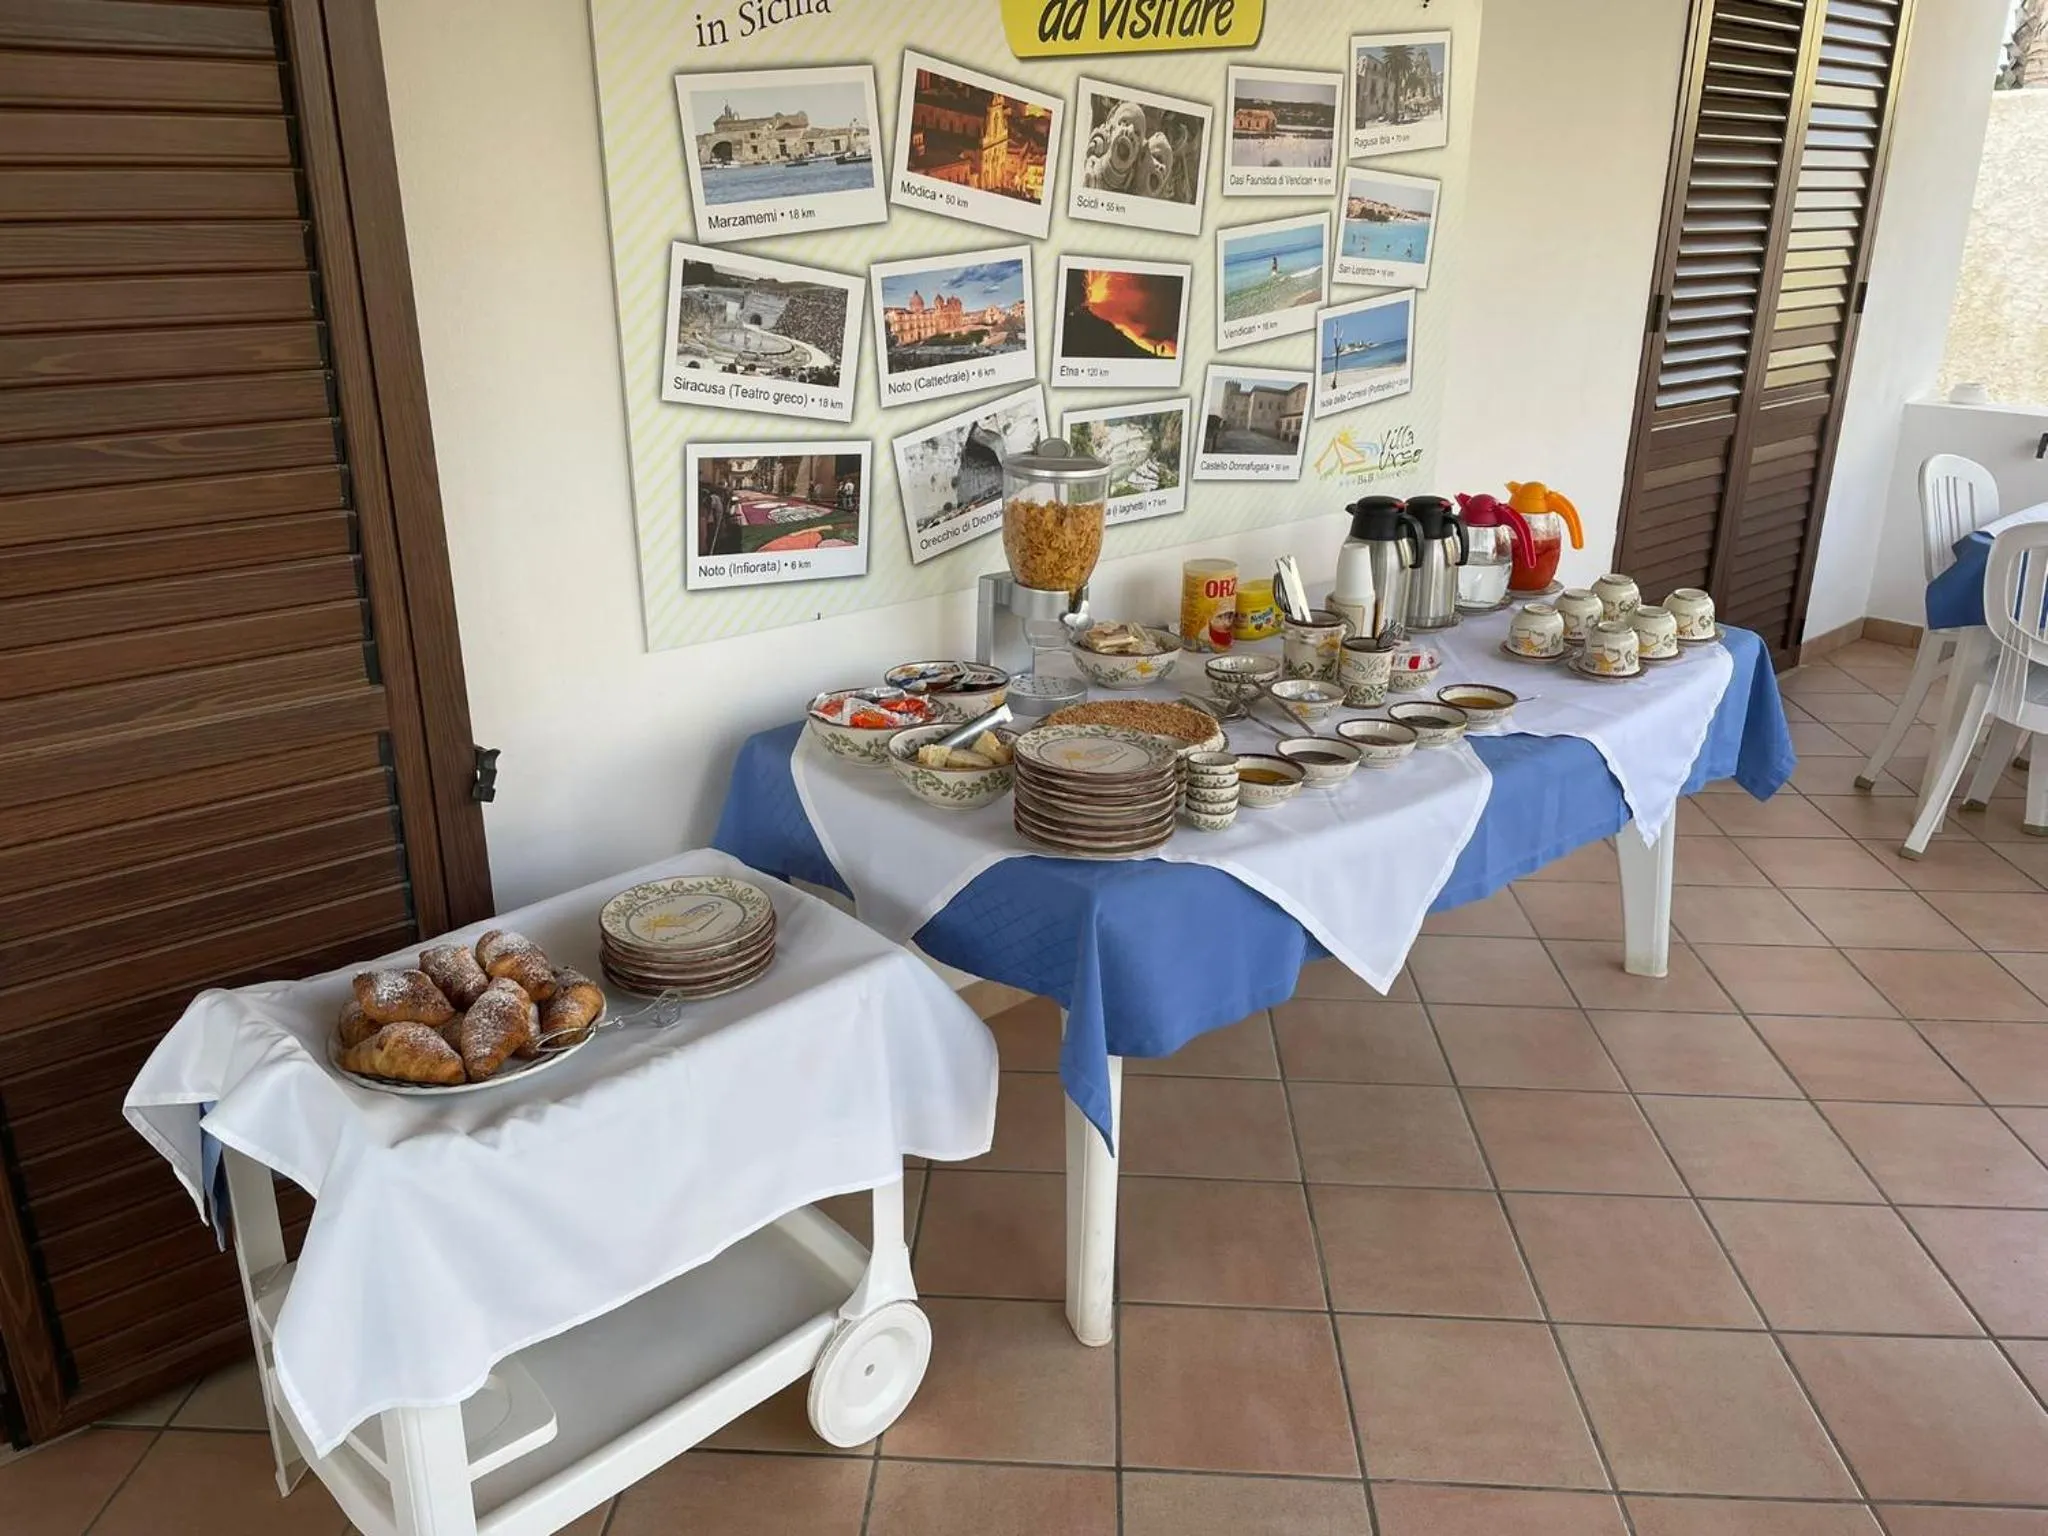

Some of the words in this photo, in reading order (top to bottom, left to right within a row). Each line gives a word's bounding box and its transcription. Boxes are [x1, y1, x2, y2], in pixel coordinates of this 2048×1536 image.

[696, 14, 729, 47] in
[1038, 0, 1089, 42] da
[1098, 0, 1235, 40] visitare
[901, 180, 936, 200] Modica
[945, 194, 955, 205] 50
[957, 196, 969, 208] km
[1077, 195, 1098, 209] Scicli
[1116, 204, 1126, 214] km
[708, 209, 778, 229] Marzamemi
[789, 209, 799, 219] 18
[801, 208, 816, 219] km
[888, 382, 911, 395] Noto
[914, 369, 970, 393] (Cattedrale)
[984, 367, 996, 377] km
[1060, 365, 1079, 377] Etna
[1099, 367, 1109, 377] km
[673, 376, 726, 395] Siracusa
[729, 384, 770, 401] (Teatro
[772, 392, 808, 408] greco)
[830, 399, 843, 409] km
[920, 517, 961, 549] Orecchio
[962, 511, 971, 532] di
[698, 565, 726, 577] Noto
[729, 560, 780, 578] (Infiorata)
[791, 561, 797, 570] 6
[798, 561, 811, 569] km
[1205, 577, 1238, 598] ORZ
